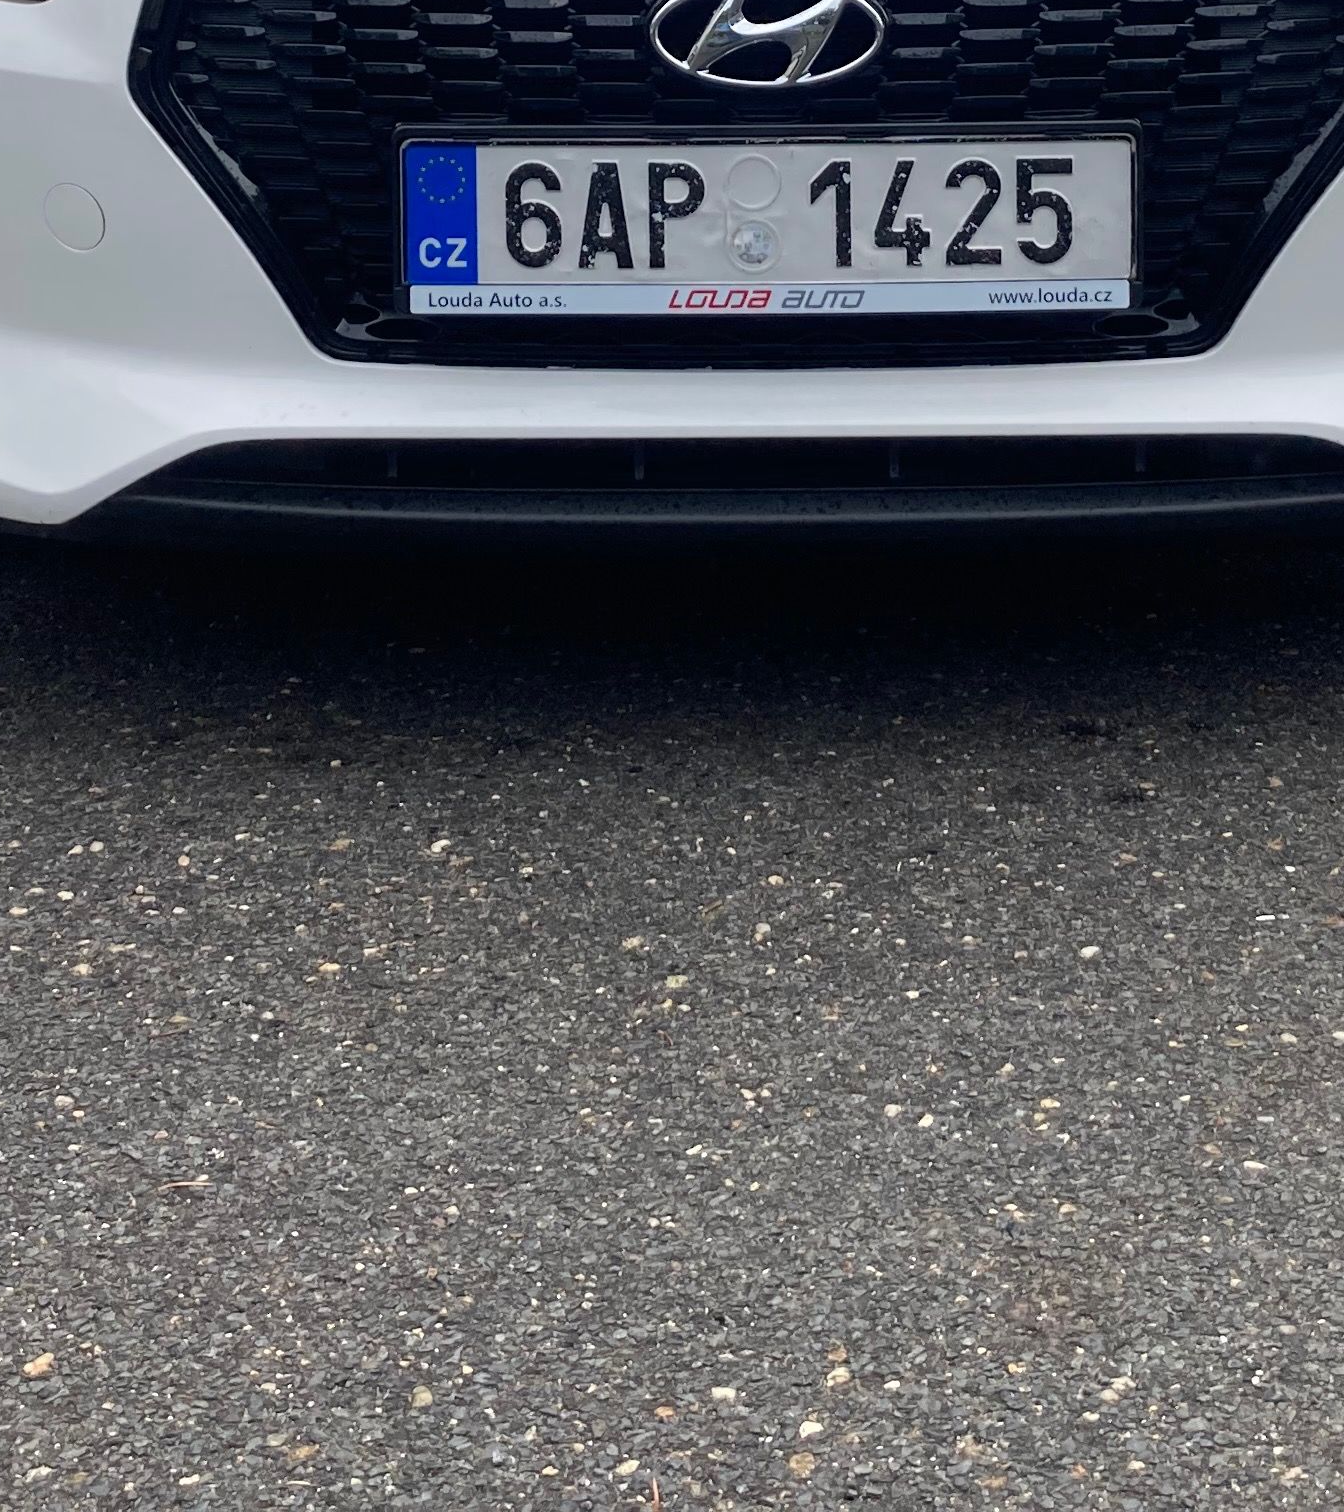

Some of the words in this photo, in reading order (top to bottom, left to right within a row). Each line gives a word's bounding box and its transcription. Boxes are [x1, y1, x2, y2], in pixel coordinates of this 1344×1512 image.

[504, 160, 707, 270] 6AP
[809, 156, 1075, 268] 1425
[417, 237, 469, 270] CZ
[428, 292, 484, 308] Louda
[489, 292, 533, 308] Auto
[538, 295, 567, 308] a.s.
[988, 287, 1113, 305] www.louda.cz
